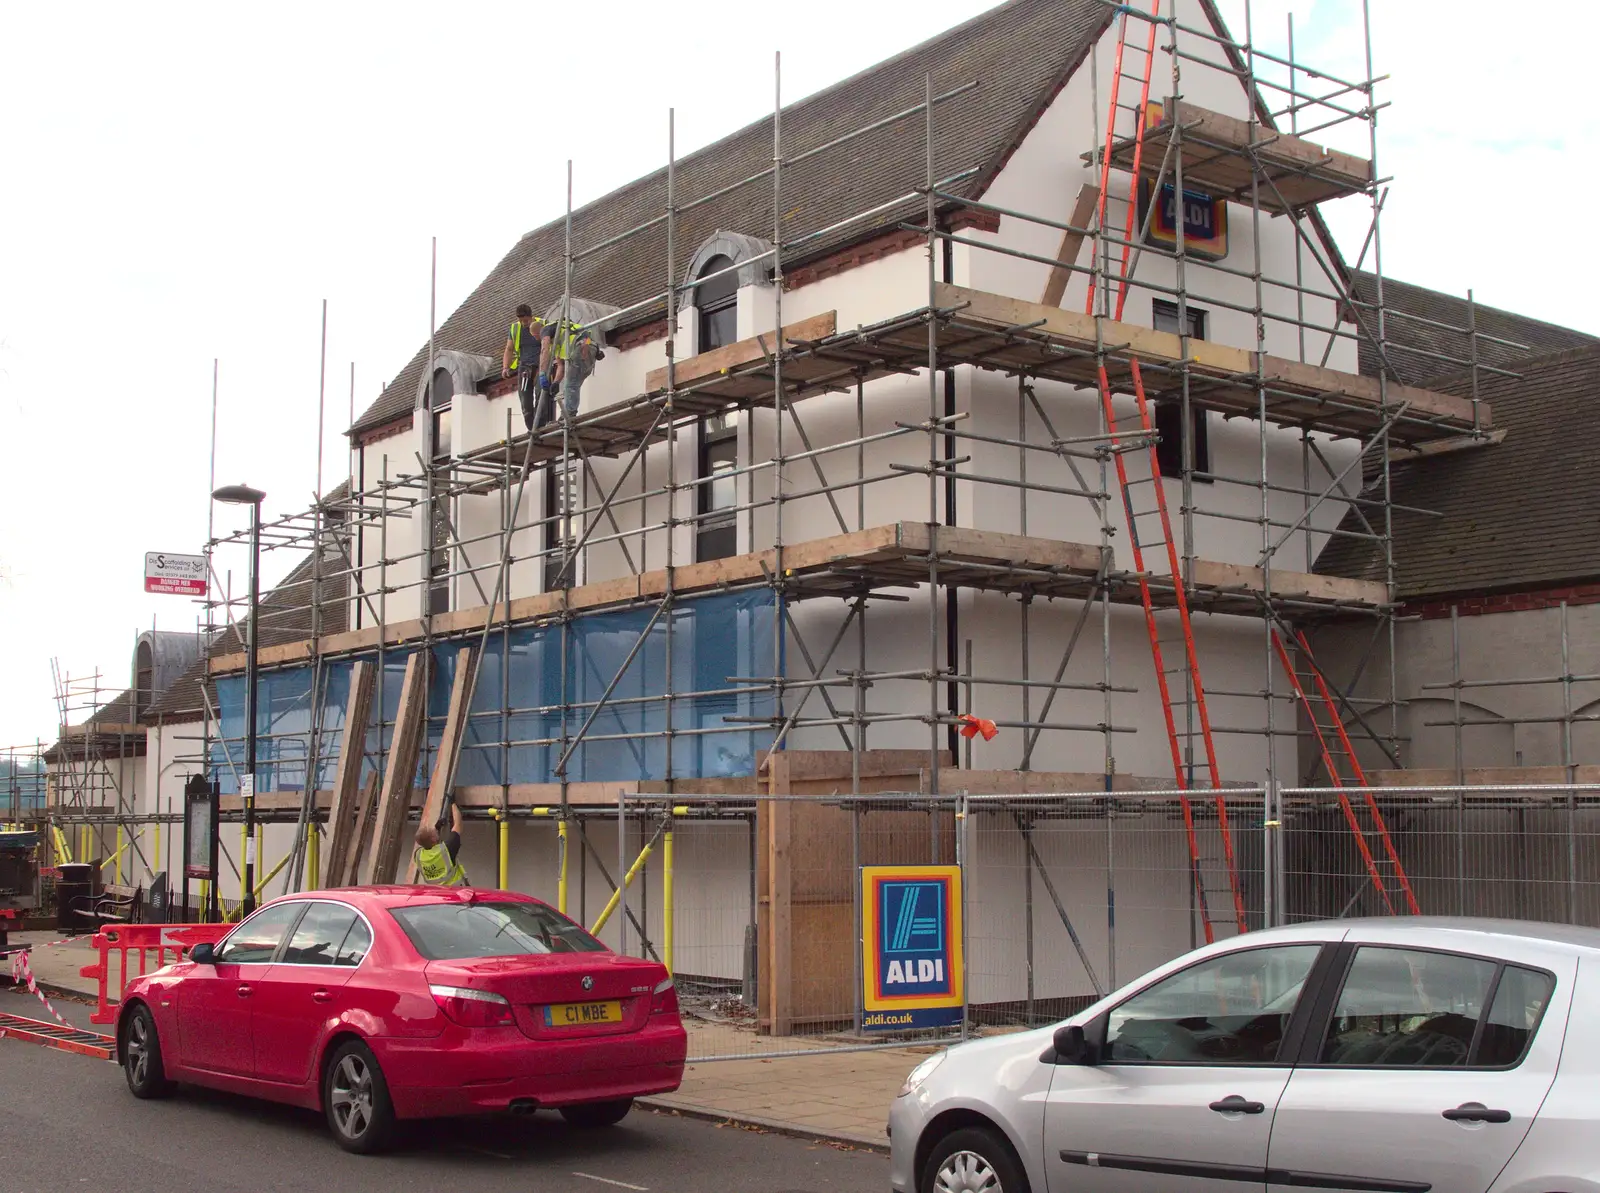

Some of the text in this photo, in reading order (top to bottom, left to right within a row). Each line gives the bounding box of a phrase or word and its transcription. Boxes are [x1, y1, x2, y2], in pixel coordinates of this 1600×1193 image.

[1166, 198, 1209, 228] ALDI
[150, 584, 173, 592] WORKING
[886, 958, 943, 984] ALDI
[865, 1012, 913, 1026] aldi.co.uk
